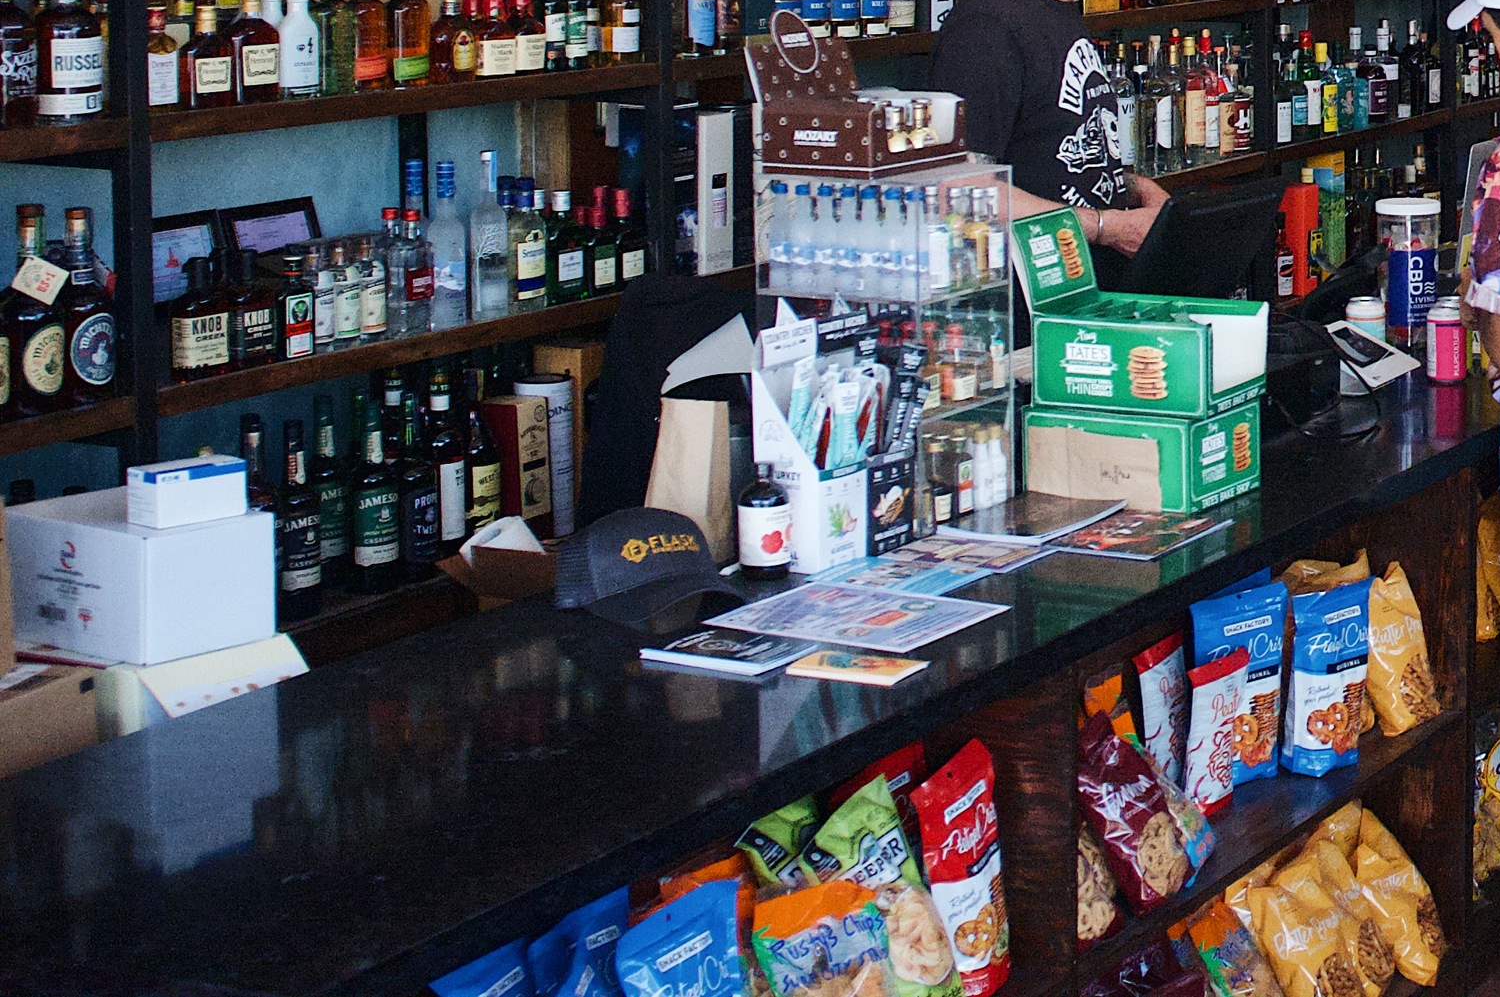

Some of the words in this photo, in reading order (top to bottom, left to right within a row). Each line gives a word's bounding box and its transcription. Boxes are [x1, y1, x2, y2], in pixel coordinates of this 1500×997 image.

[793, 130, 838, 142] MOZART
[1409, 256, 1424, 296] CBD
[191, 315, 222, 336] KNOB
[244, 308, 270, 327] KNOB
[195, 331, 226, 343] CREEK
[1067, 346, 1109, 360] TATE'S
[1066, 382, 1091, 395] THIN
[359, 492, 398, 509] JAMESO
[283, 515, 320, 532] JAMES
[648, 534, 694, 549] FLASK
[842, 912, 885, 942] Chips
